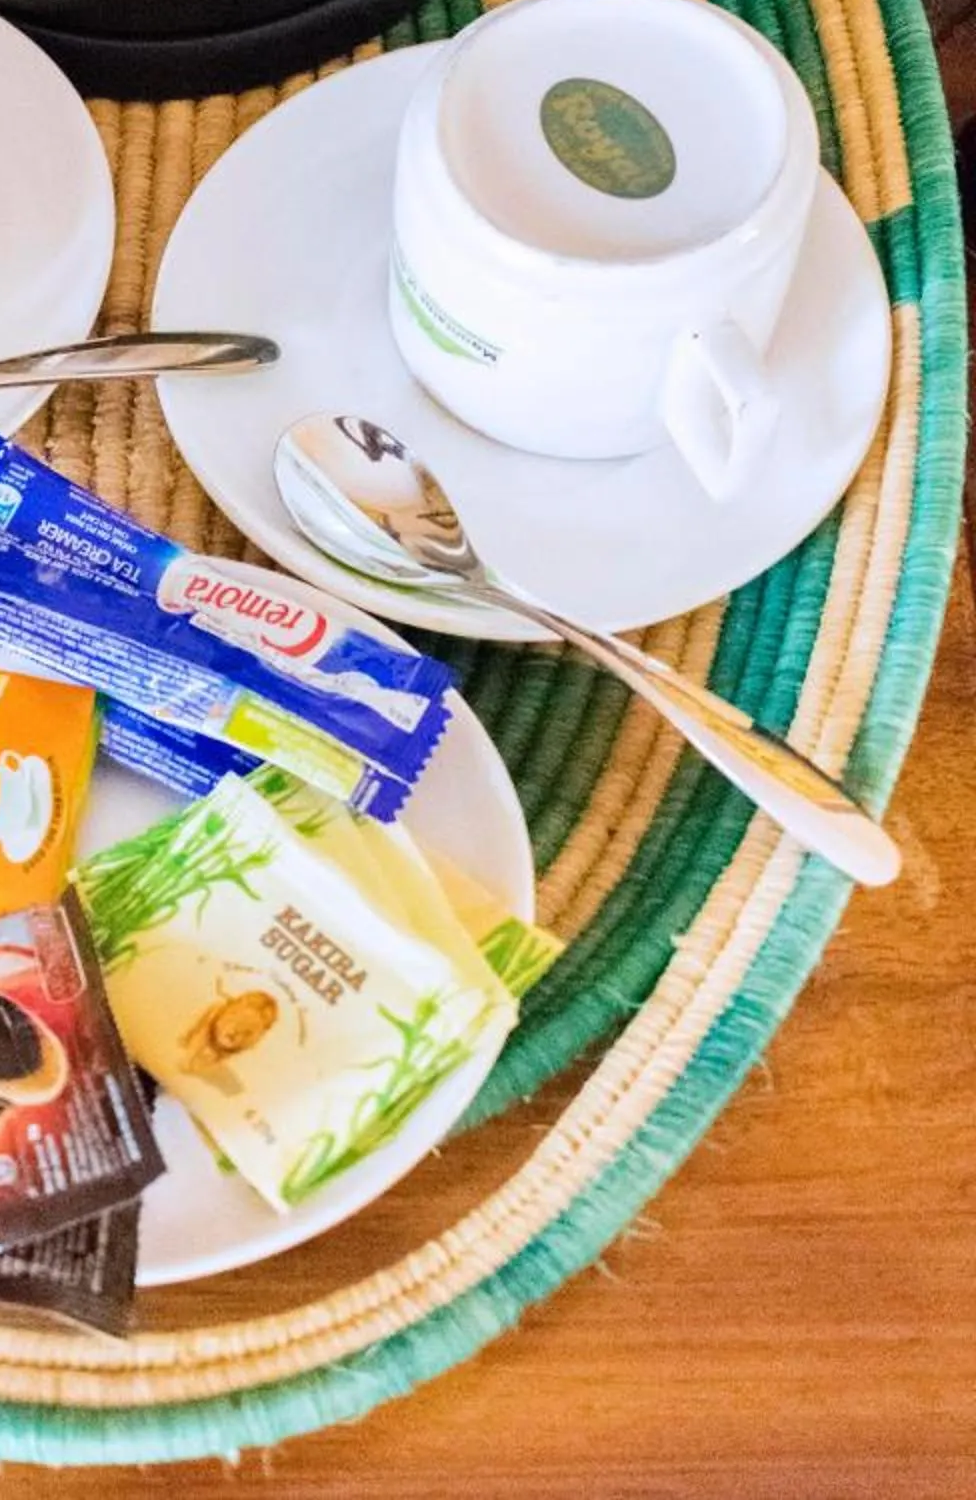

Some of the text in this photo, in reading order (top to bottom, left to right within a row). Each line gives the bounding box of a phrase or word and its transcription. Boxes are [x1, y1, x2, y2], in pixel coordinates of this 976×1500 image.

[37, 519, 112, 565] CREAMER
[112, 556, 141, 584] TEA
[183, 574, 327, 657] Cremora
[259, 927, 343, 1006] SUGAR
[273, 904, 368, 993] KAKIRA
